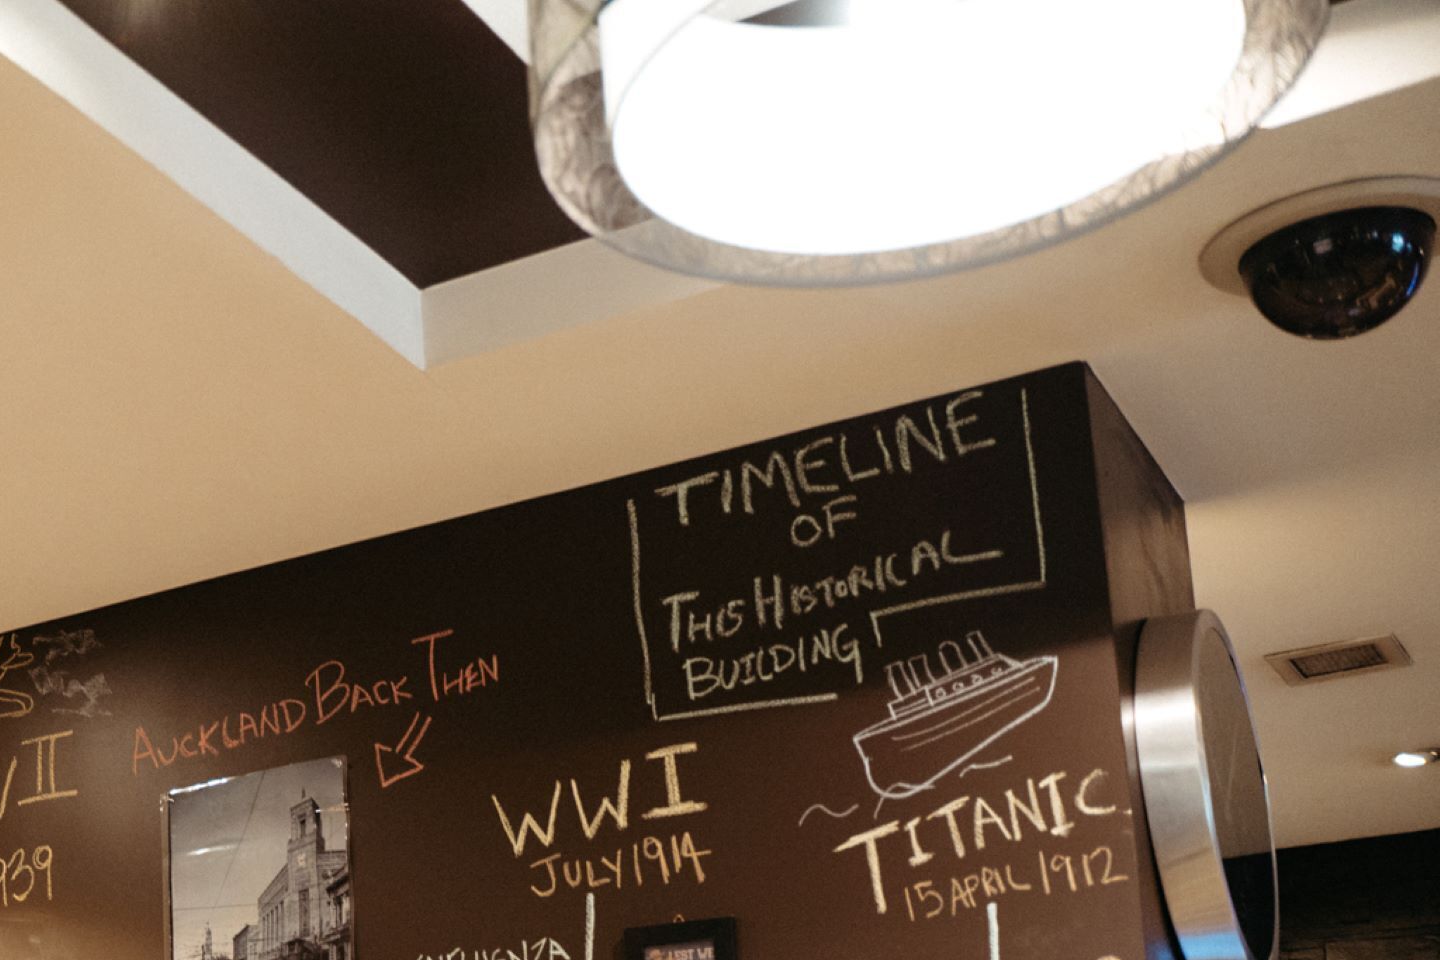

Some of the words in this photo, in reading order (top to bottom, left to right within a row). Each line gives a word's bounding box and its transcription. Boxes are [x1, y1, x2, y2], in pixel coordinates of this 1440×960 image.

[655, 390, 996, 526] TIMELINE
[790, 494, 857, 546] OF
[663, 591, 744, 652] THIS
[754, 531, 1003, 629] HISTORICAL
[682, 623, 863, 699] BUILDING
[132, 699, 306, 775] AUCKLAND
[306, 660, 414, 725] BACK
[412, 628, 500, 701] THEN
[530, 847, 623, 898] JULY
[631, 832, 712, 884] 1914
[903, 880, 945, 922] 15
[951, 865, 1032, 917] APRIL
[1038, 846, 1129, 895] 1912
